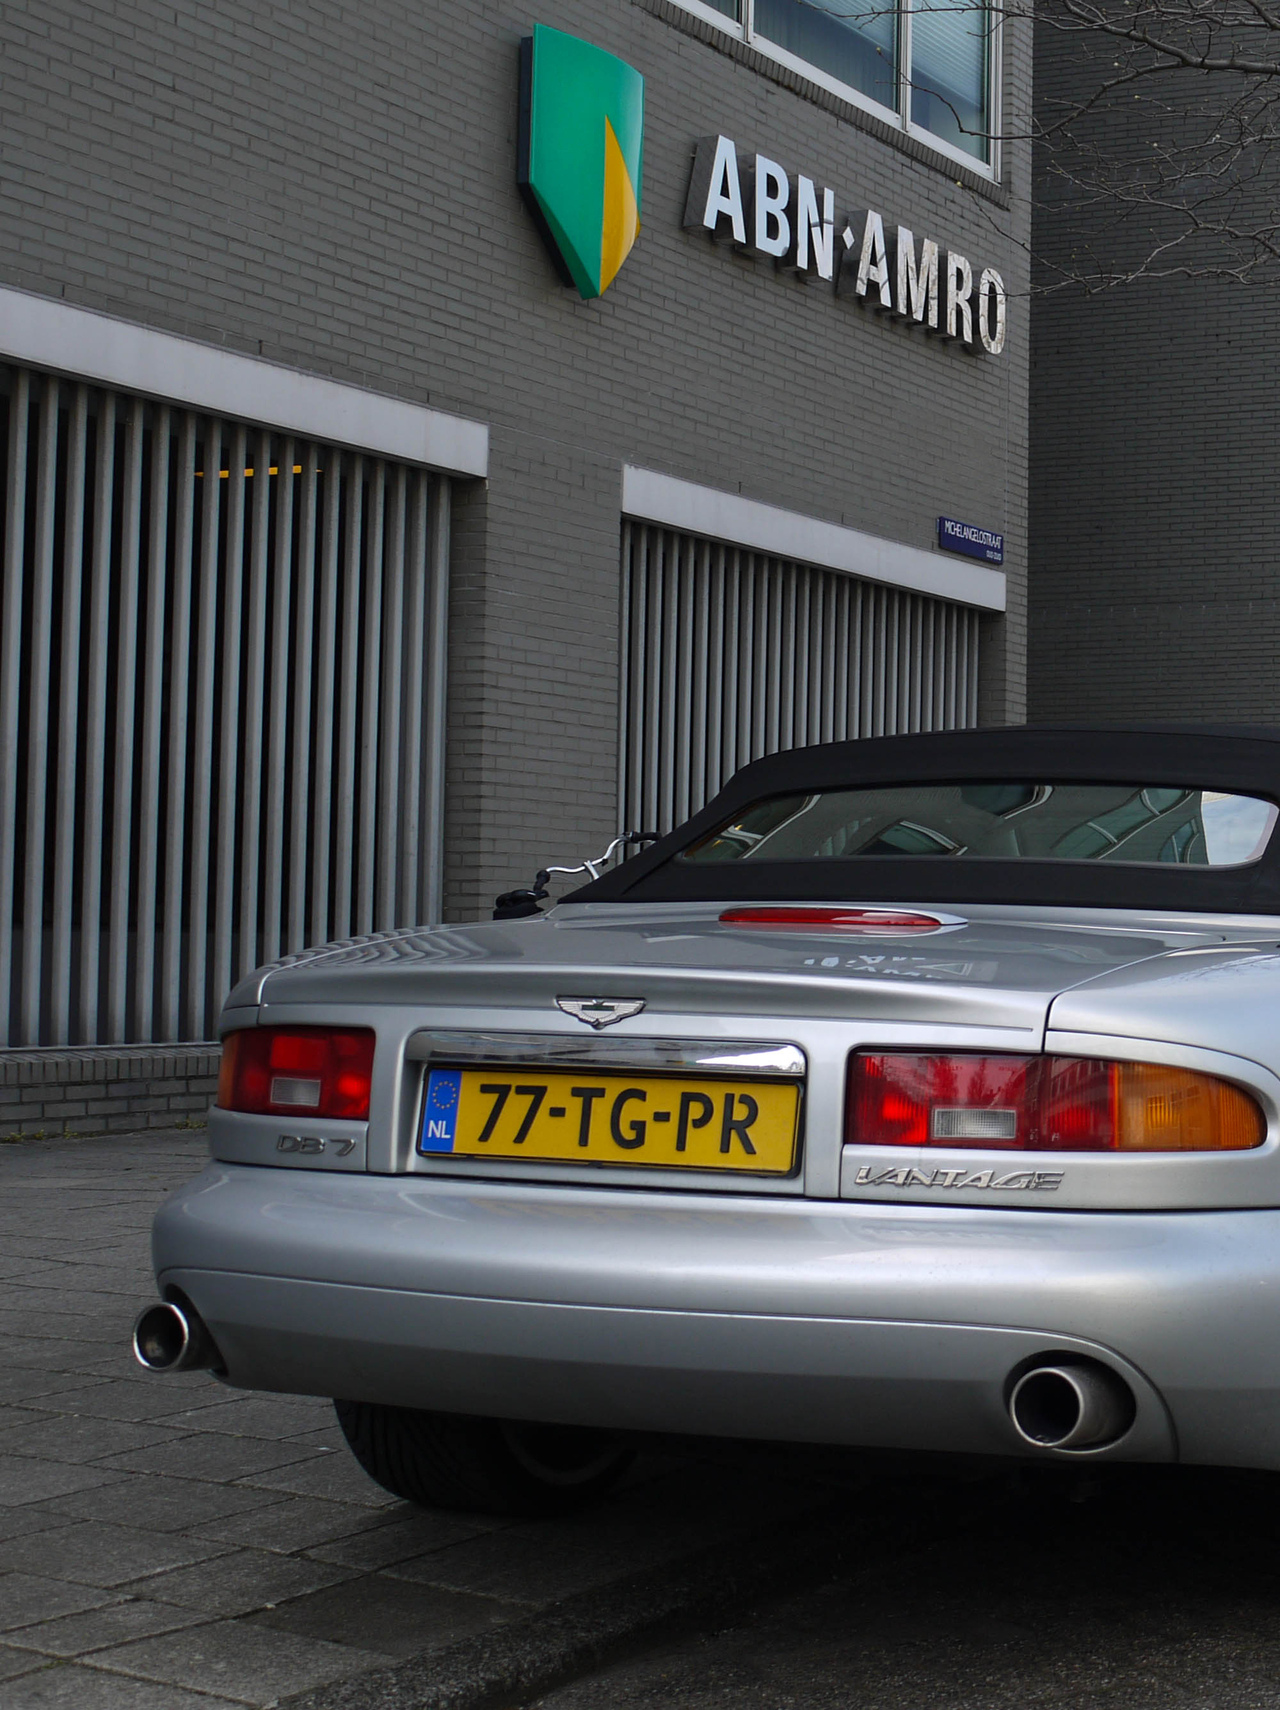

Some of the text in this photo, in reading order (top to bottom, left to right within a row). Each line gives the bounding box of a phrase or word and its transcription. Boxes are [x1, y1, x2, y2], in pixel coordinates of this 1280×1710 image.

[427, 1083, 758, 1156] NL 77-TG-PR
[854, 1165, 1066, 1190] VANTAGE
